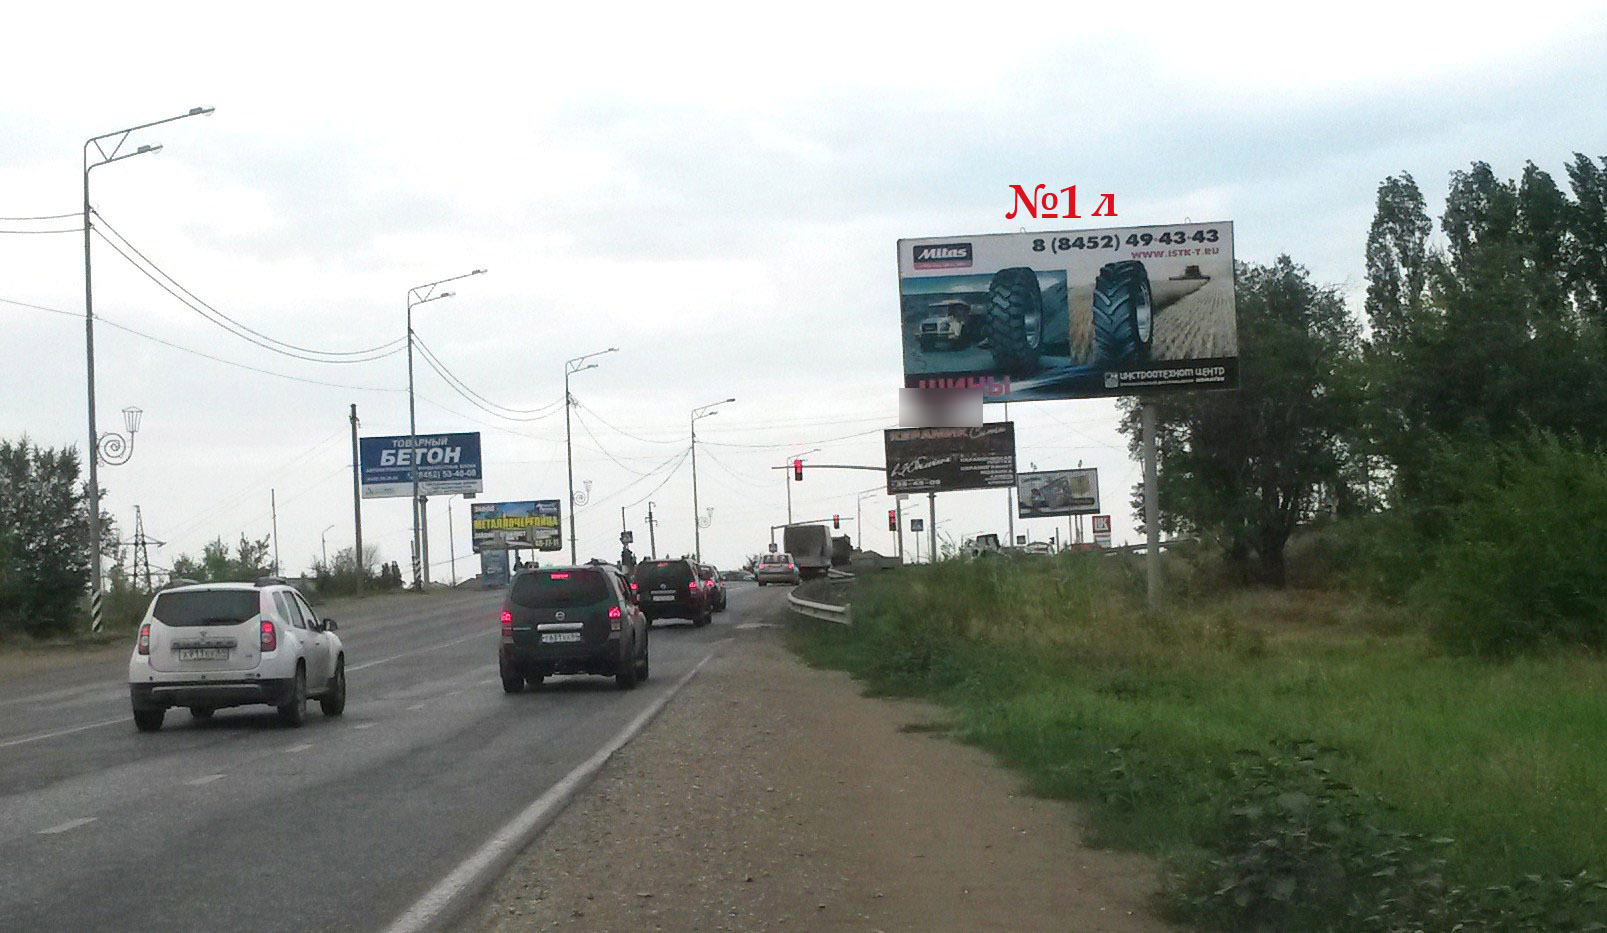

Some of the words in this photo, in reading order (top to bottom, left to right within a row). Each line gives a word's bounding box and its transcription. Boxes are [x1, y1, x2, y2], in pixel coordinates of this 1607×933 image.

[917, 247, 967, 260] Mitas
[1032, 238, 1046, 253] 8
[1051, 234, 1121, 254] (8452)
[380, 446, 462, 467] БЕТОН
